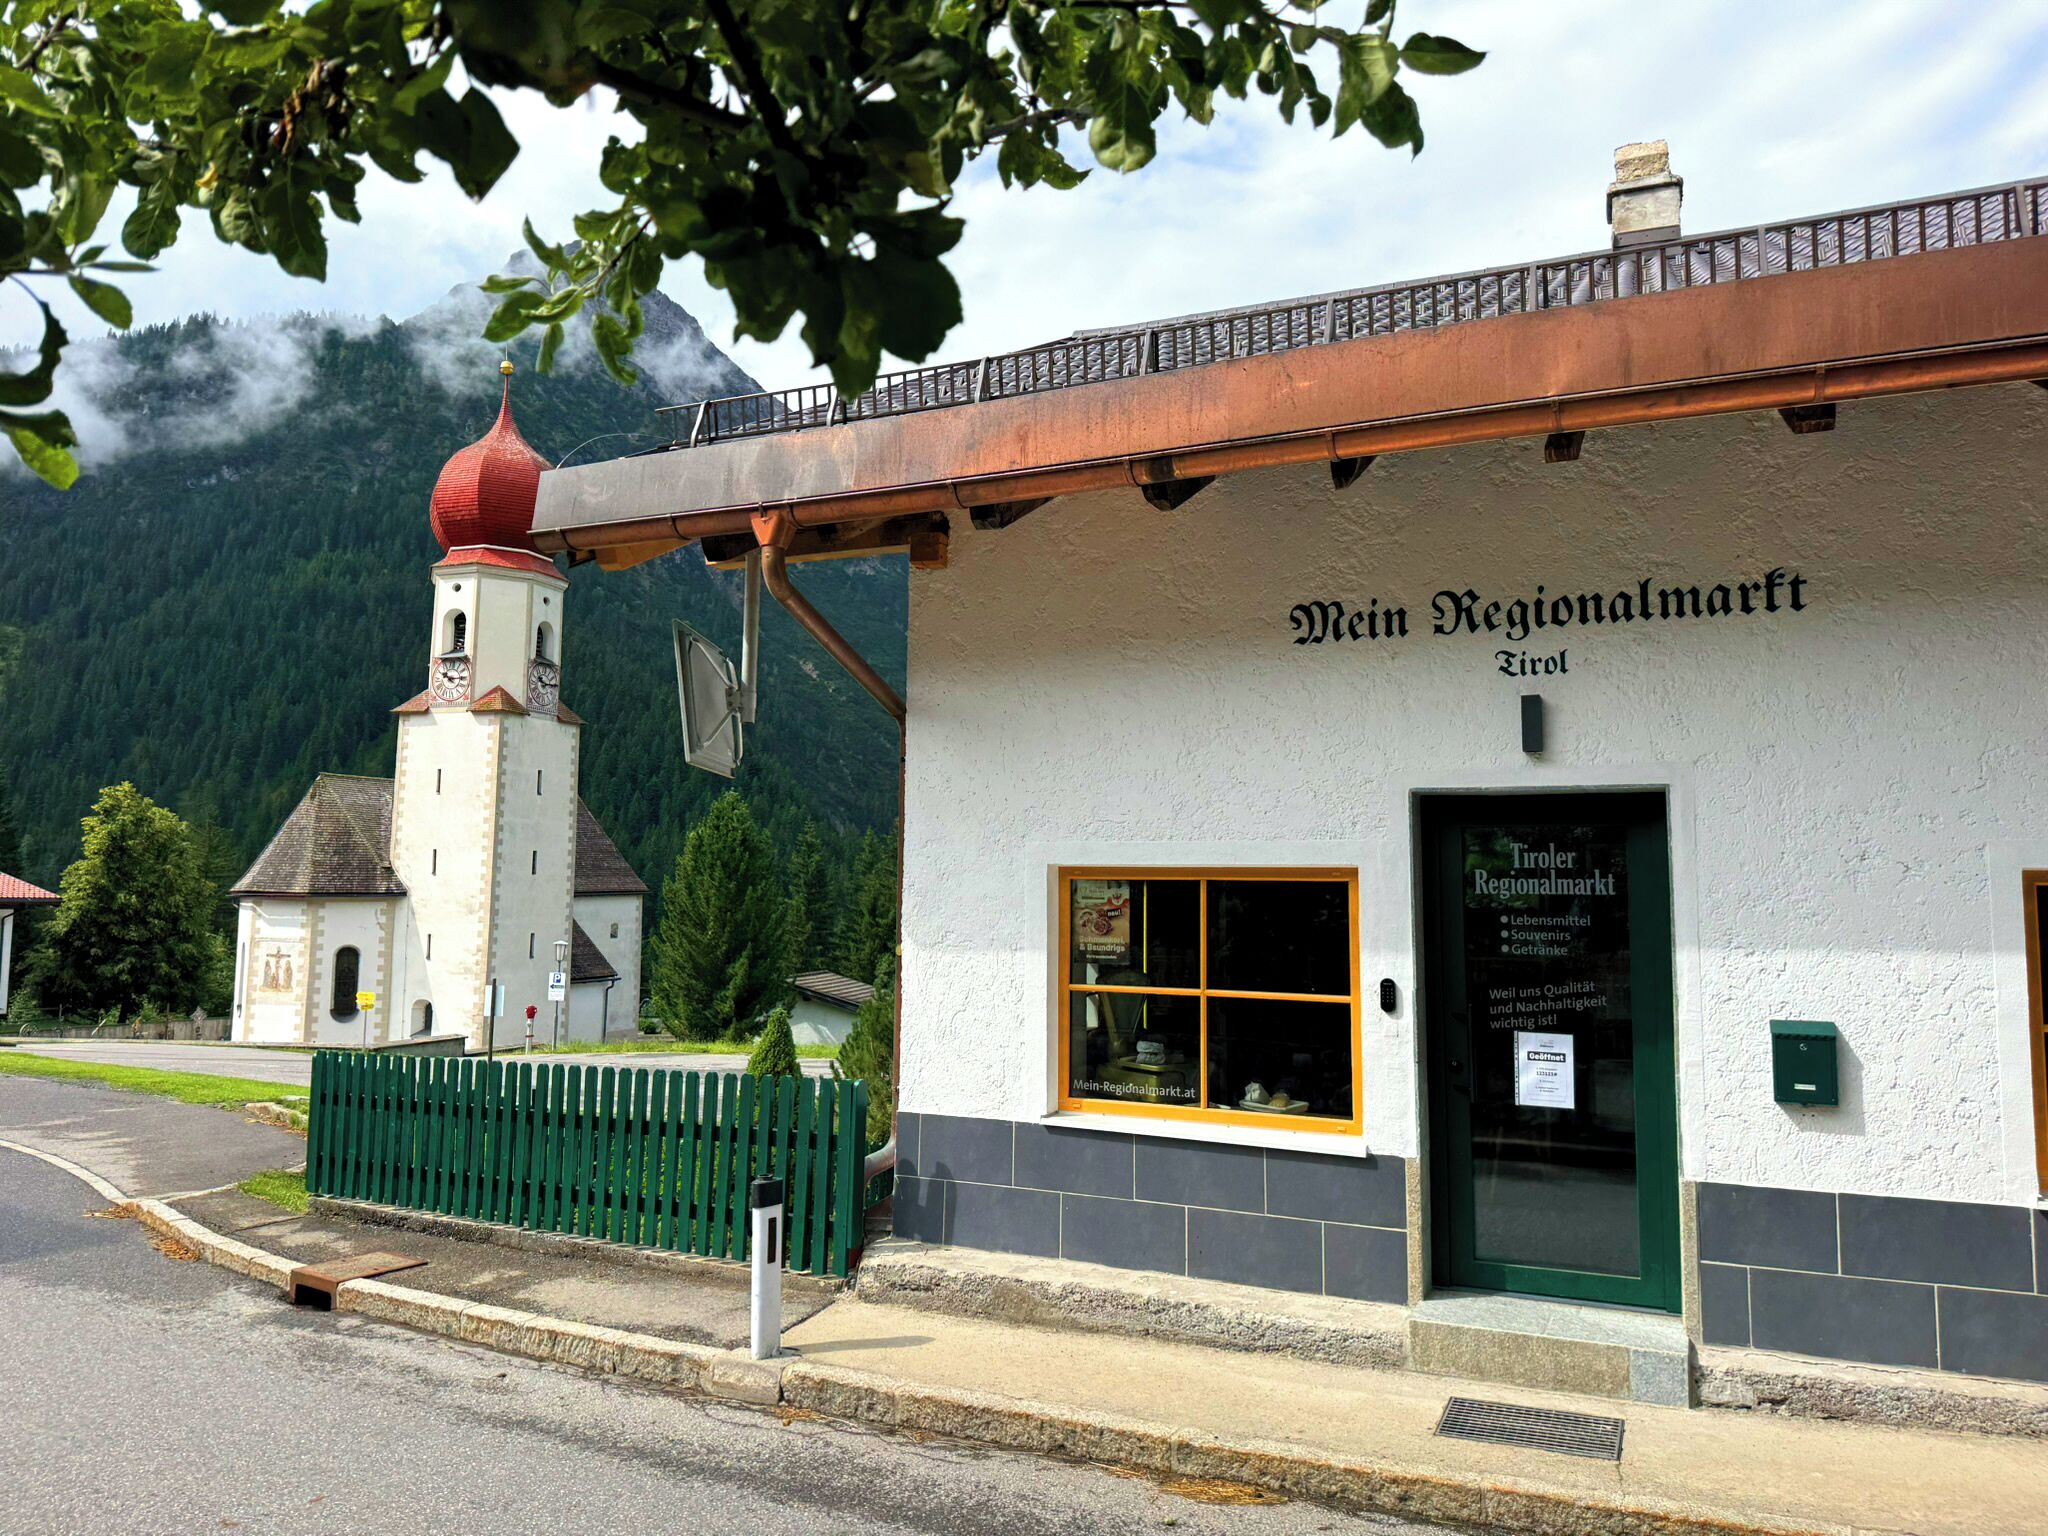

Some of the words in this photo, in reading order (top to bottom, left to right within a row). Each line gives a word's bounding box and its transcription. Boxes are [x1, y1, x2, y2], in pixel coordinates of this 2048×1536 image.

[1289, 598, 1409, 645] Mein
[1431, 566, 1808, 641] Regionalmarkt
[1495, 648, 1569, 677] Tirol
[1510, 843, 1576, 869] Tiroler
[1474, 868, 1616, 899] Regionalmarkt
[1510, 914, 1591, 927] Lebensmittel
[1511, 928, 1571, 942] Souvenirs
[1511, 942, 1569, 956] Getränke
[1489, 987, 1516, 1000] Weil
[1519, 987, 1541, 998] uns
[1544, 980, 1596, 998] Qualität
[1489, 1000, 1513, 1014] und
[1516, 995, 1608, 1013] Nachhaltigkeit
[1490, 1015, 1536, 1030] wichtig
[1538, 1013, 1557, 1026] ist!
[1529, 1052, 1564, 1061] Geöffnet
[1073, 1079, 1195, 1098] Mein-Regionalmarkt.at
